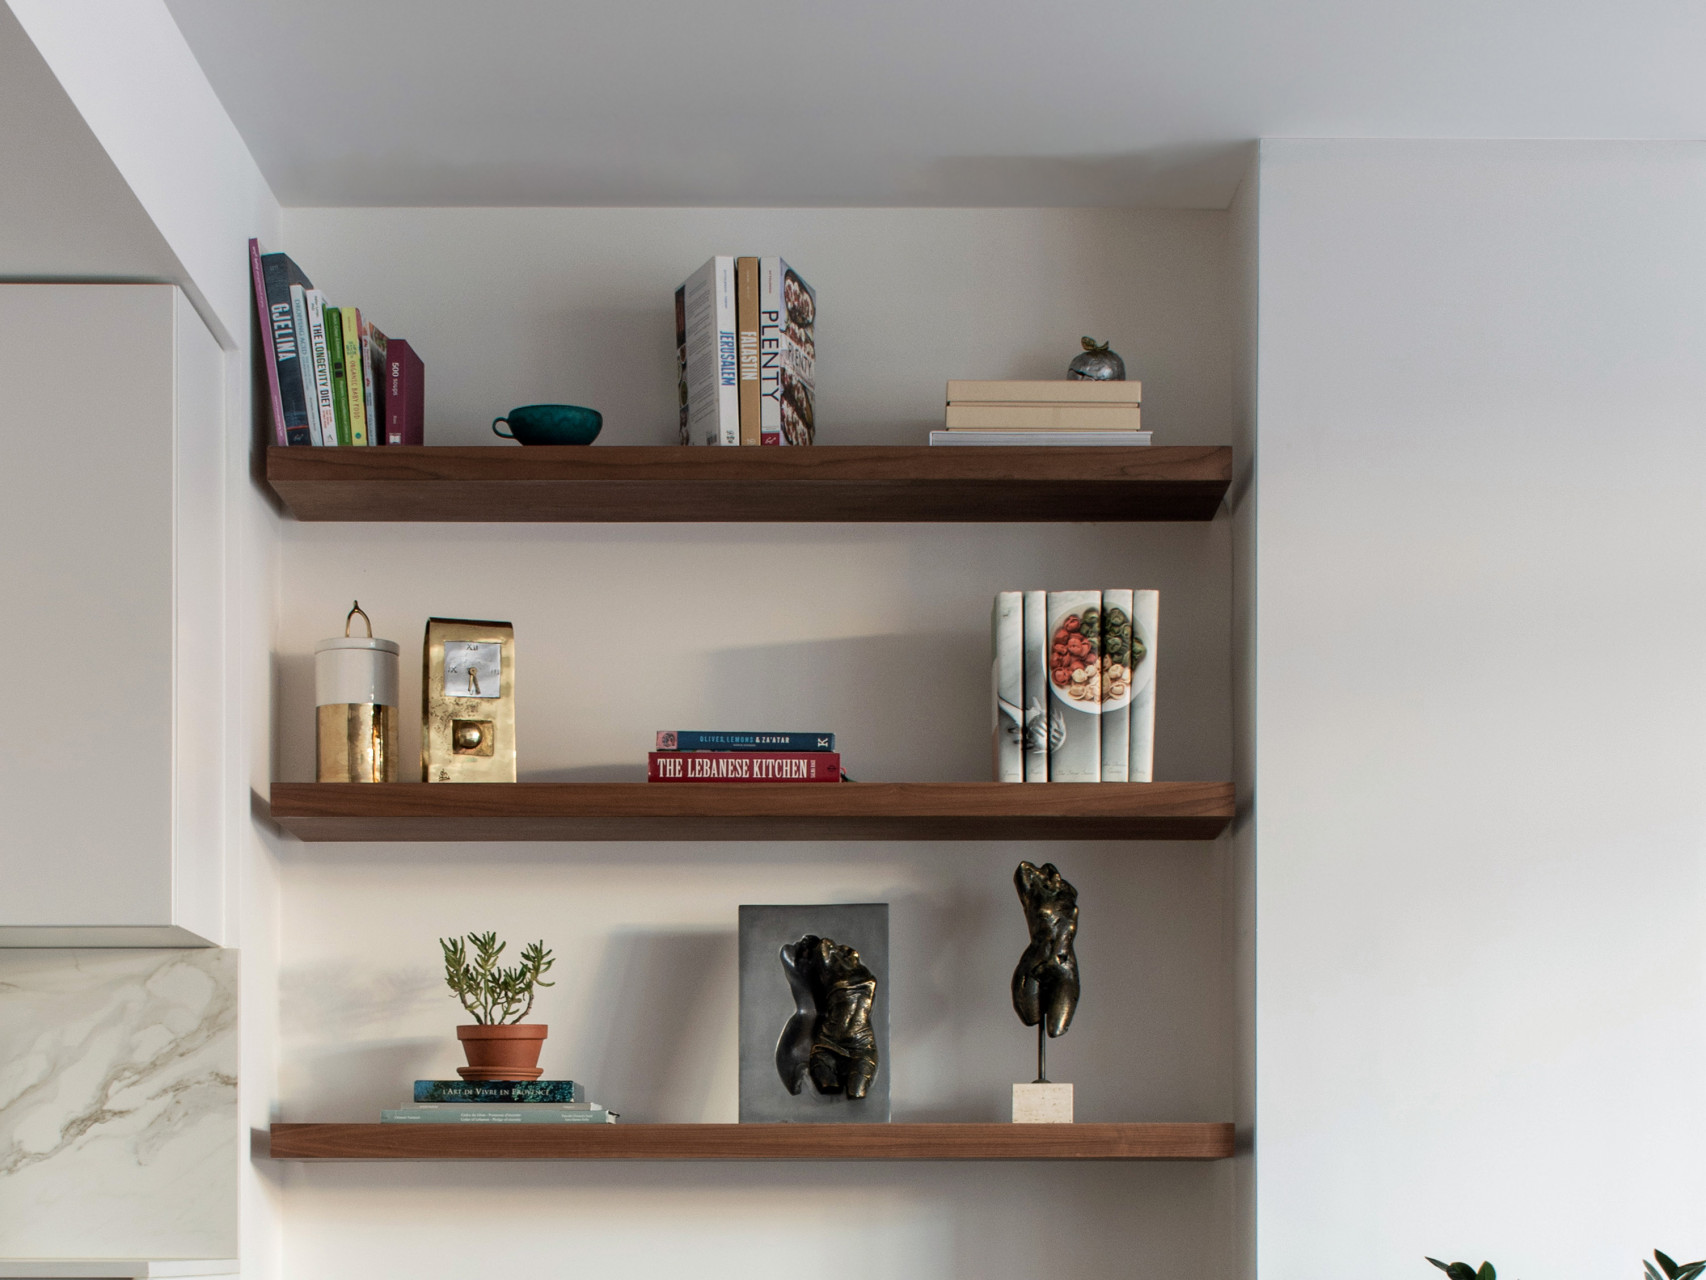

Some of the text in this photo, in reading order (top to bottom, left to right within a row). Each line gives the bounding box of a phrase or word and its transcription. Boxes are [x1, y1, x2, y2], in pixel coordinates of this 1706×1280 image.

[271, 303, 297, 362] GJELINA
[313, 323, 322, 343] THE
[314, 344, 328, 389] LONGEVITY
[719, 331, 736, 386] JERUSALEM
[740, 331, 758, 381] FALASTIN
[761, 310, 779, 402] PLENTY
[320, 389, 331, 408] DIET
[761, 736, 790, 744] ZA'ATAR
[657, 758, 808, 779] THE LEBANESE KITCHEN
